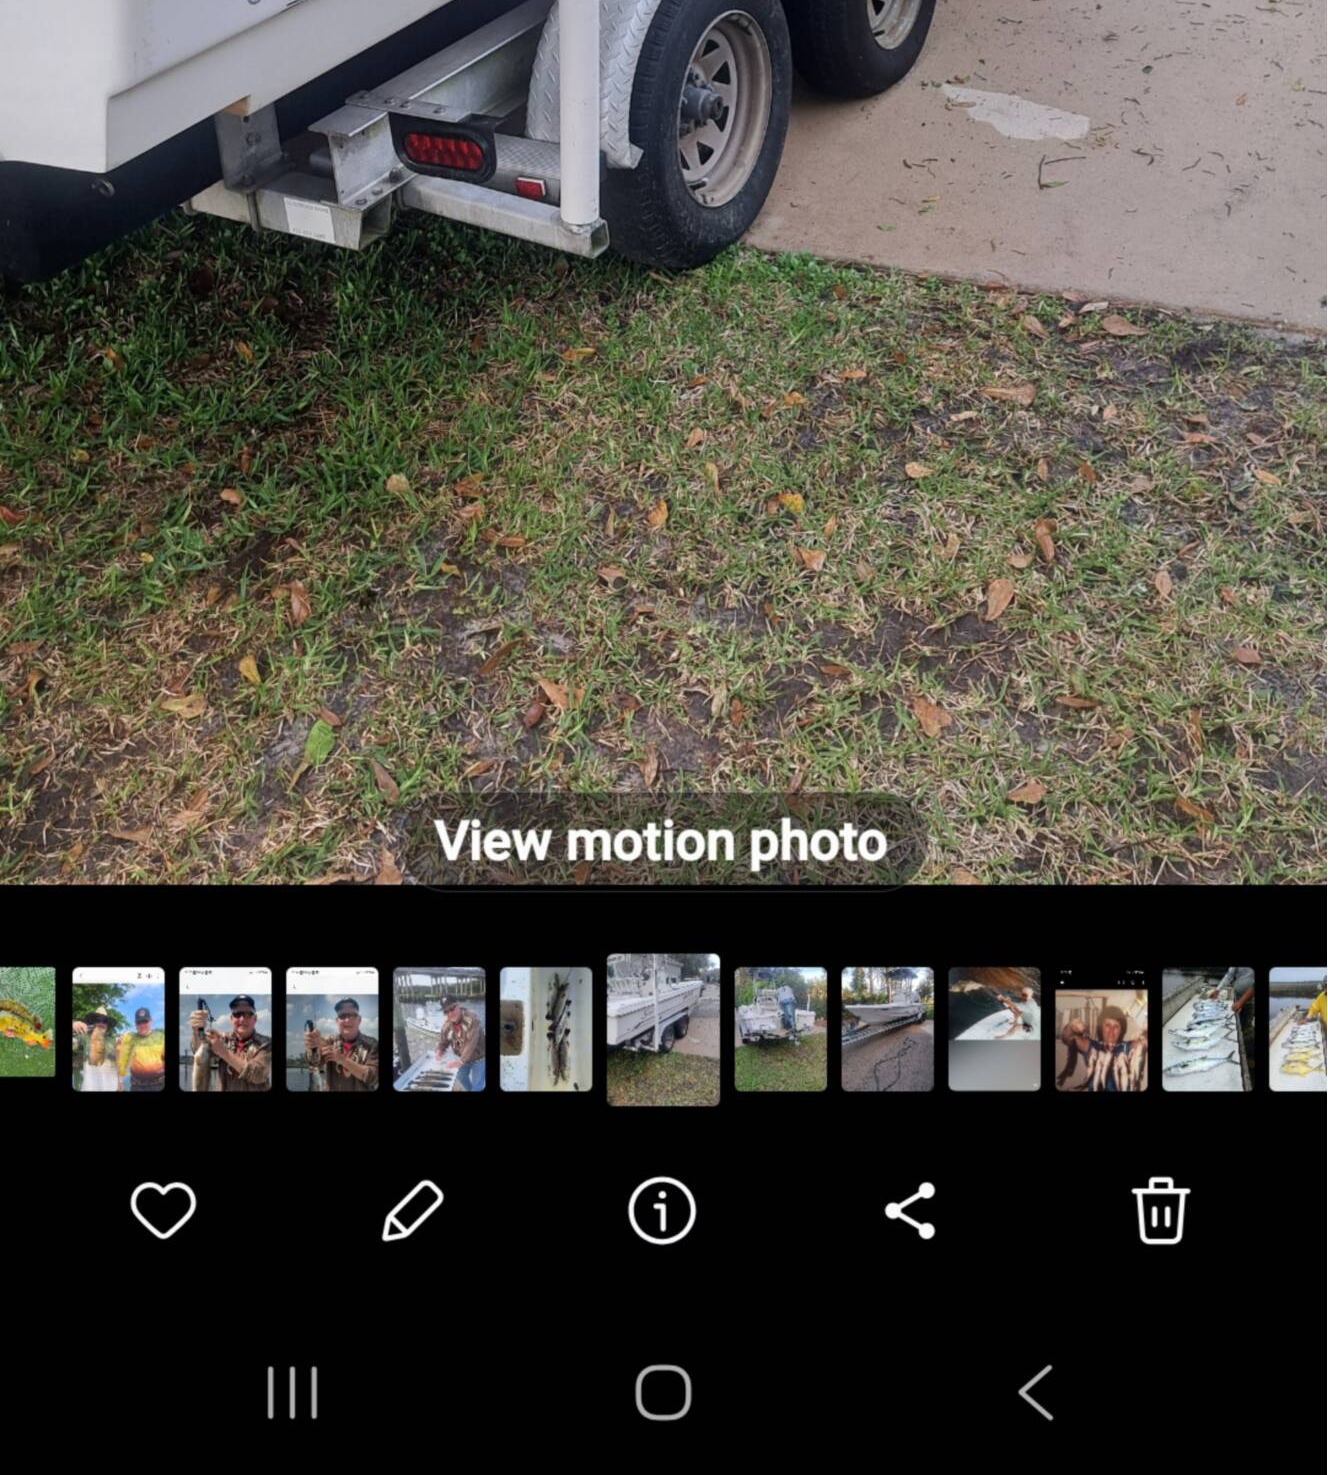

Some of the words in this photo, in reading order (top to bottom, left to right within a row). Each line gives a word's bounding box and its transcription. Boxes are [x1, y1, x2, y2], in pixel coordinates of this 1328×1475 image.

[434, 819, 551, 862] View
[568, 819, 735, 862] motion
[751, 818, 887, 872] photo
